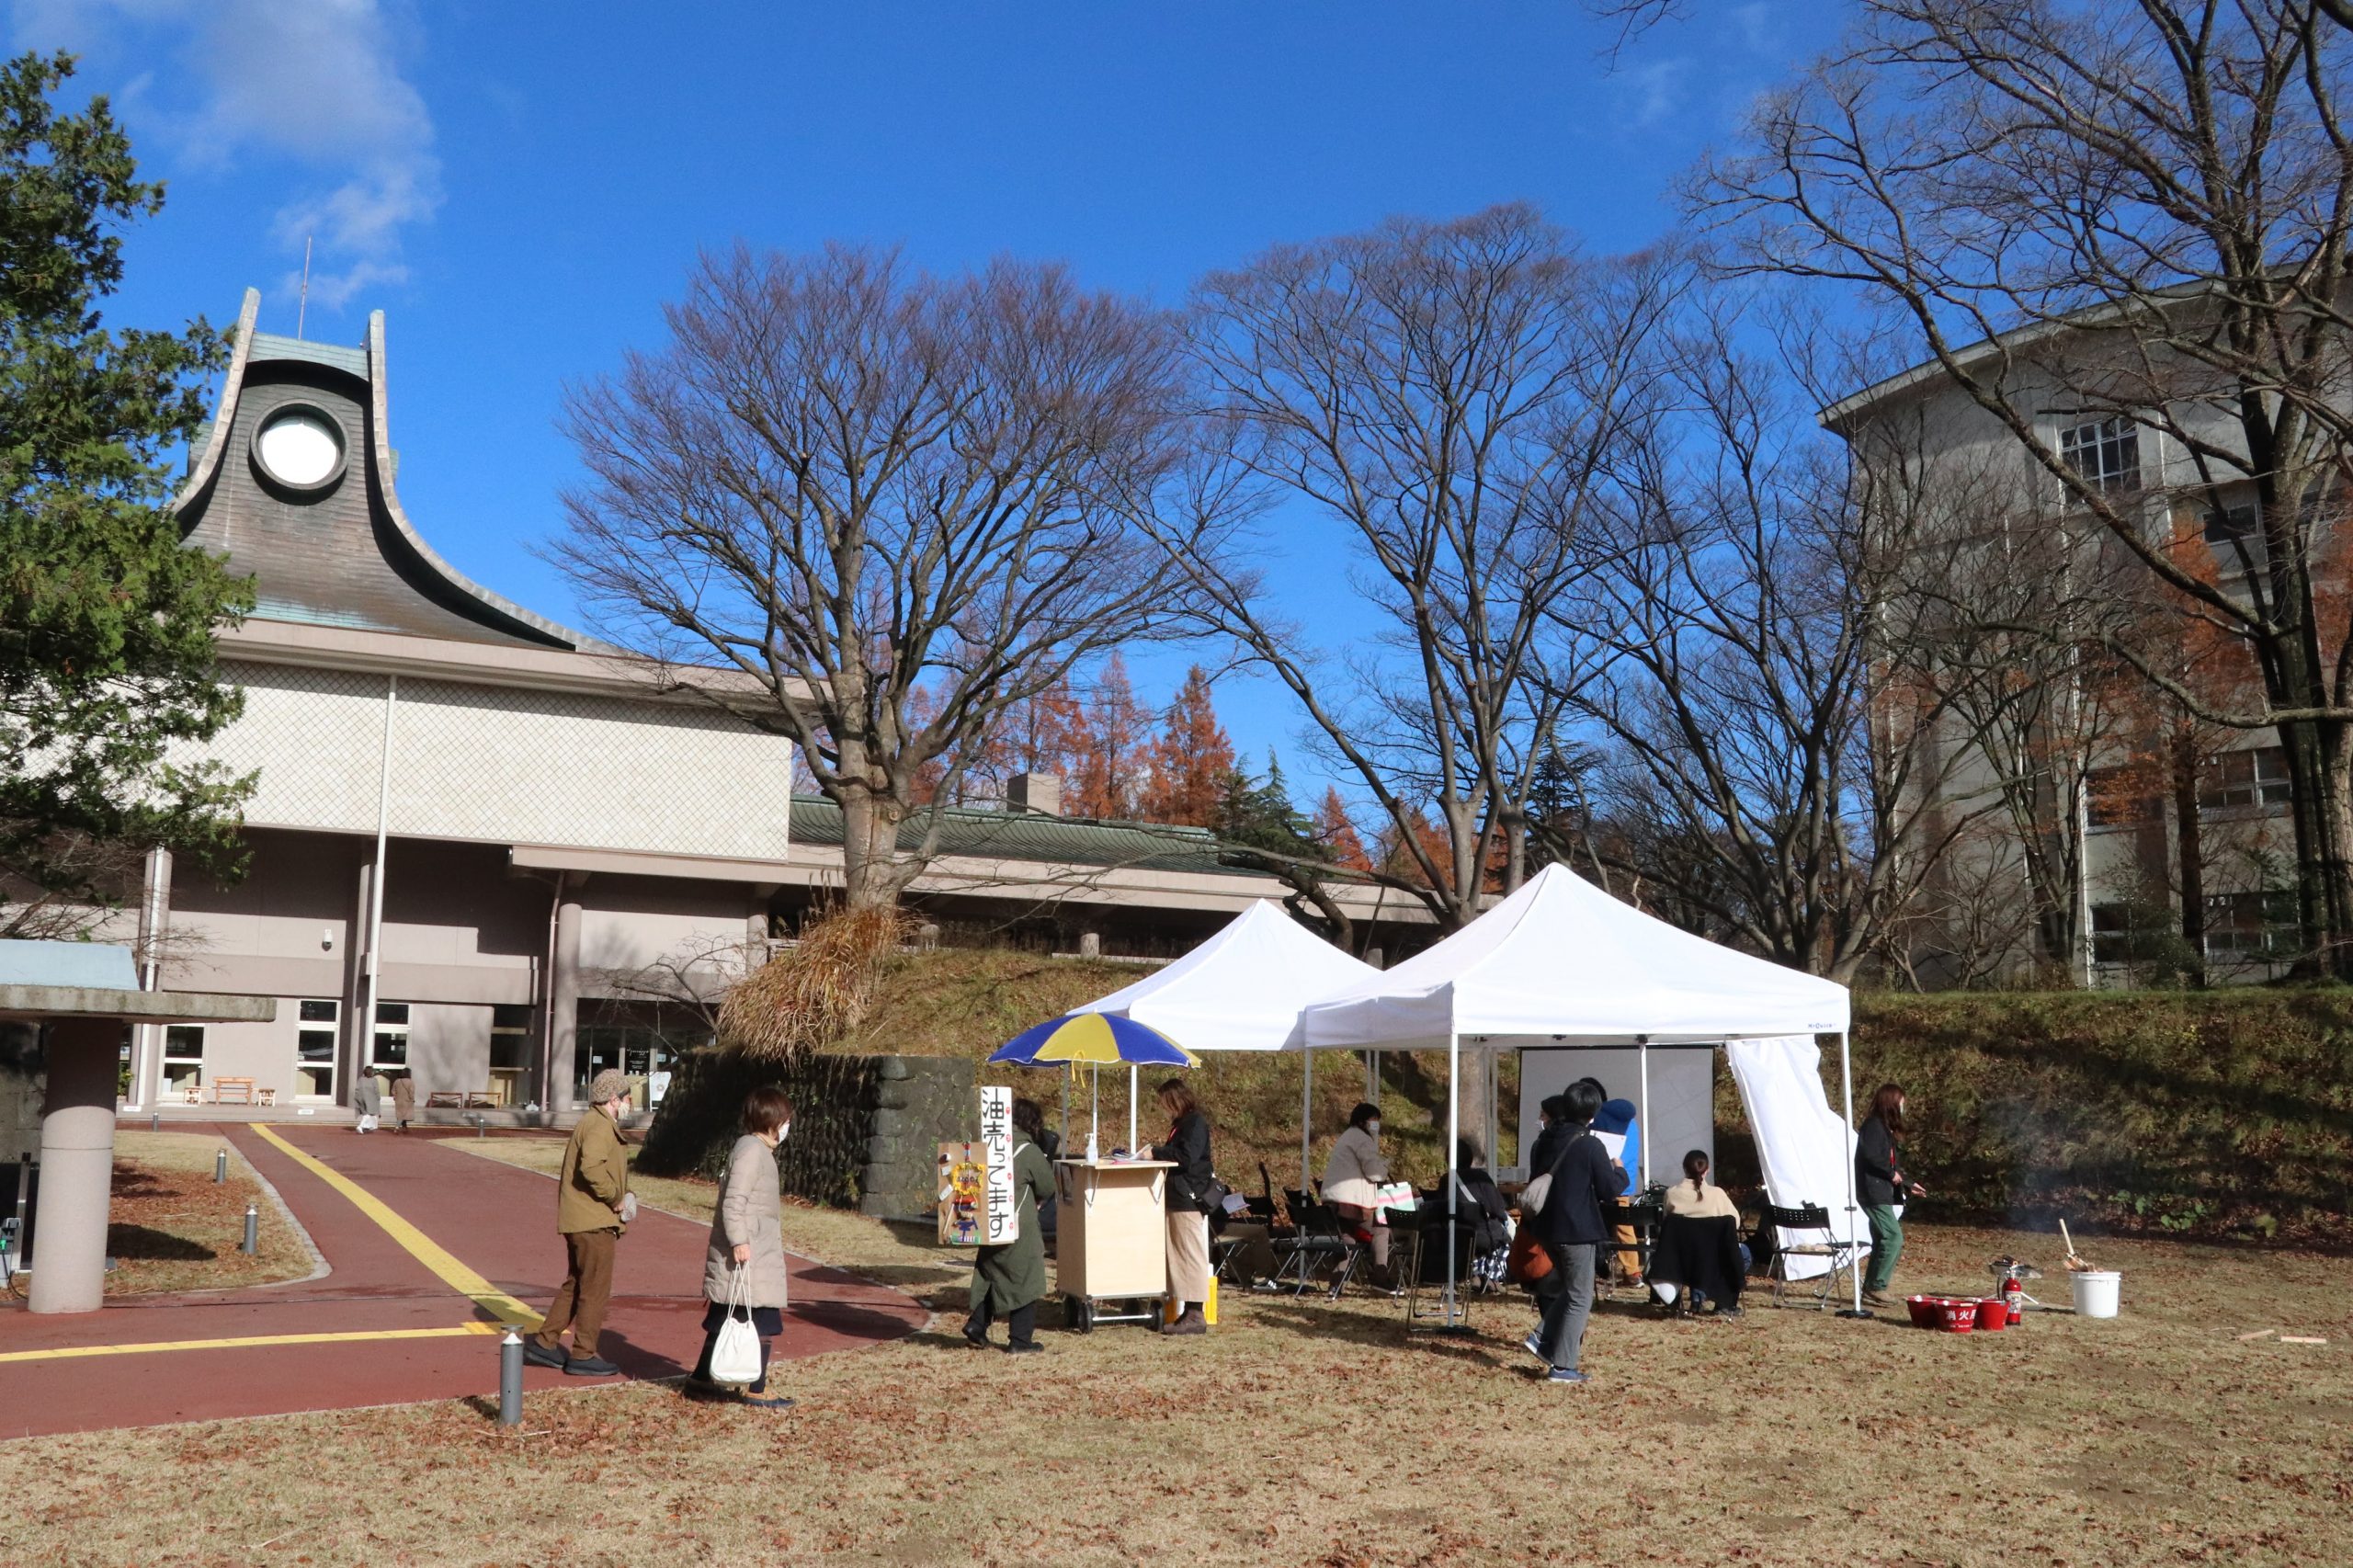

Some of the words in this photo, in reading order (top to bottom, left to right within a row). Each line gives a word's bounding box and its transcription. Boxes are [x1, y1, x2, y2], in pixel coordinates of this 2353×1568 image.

[983, 1087, 1009, 1239] 油売ってます
